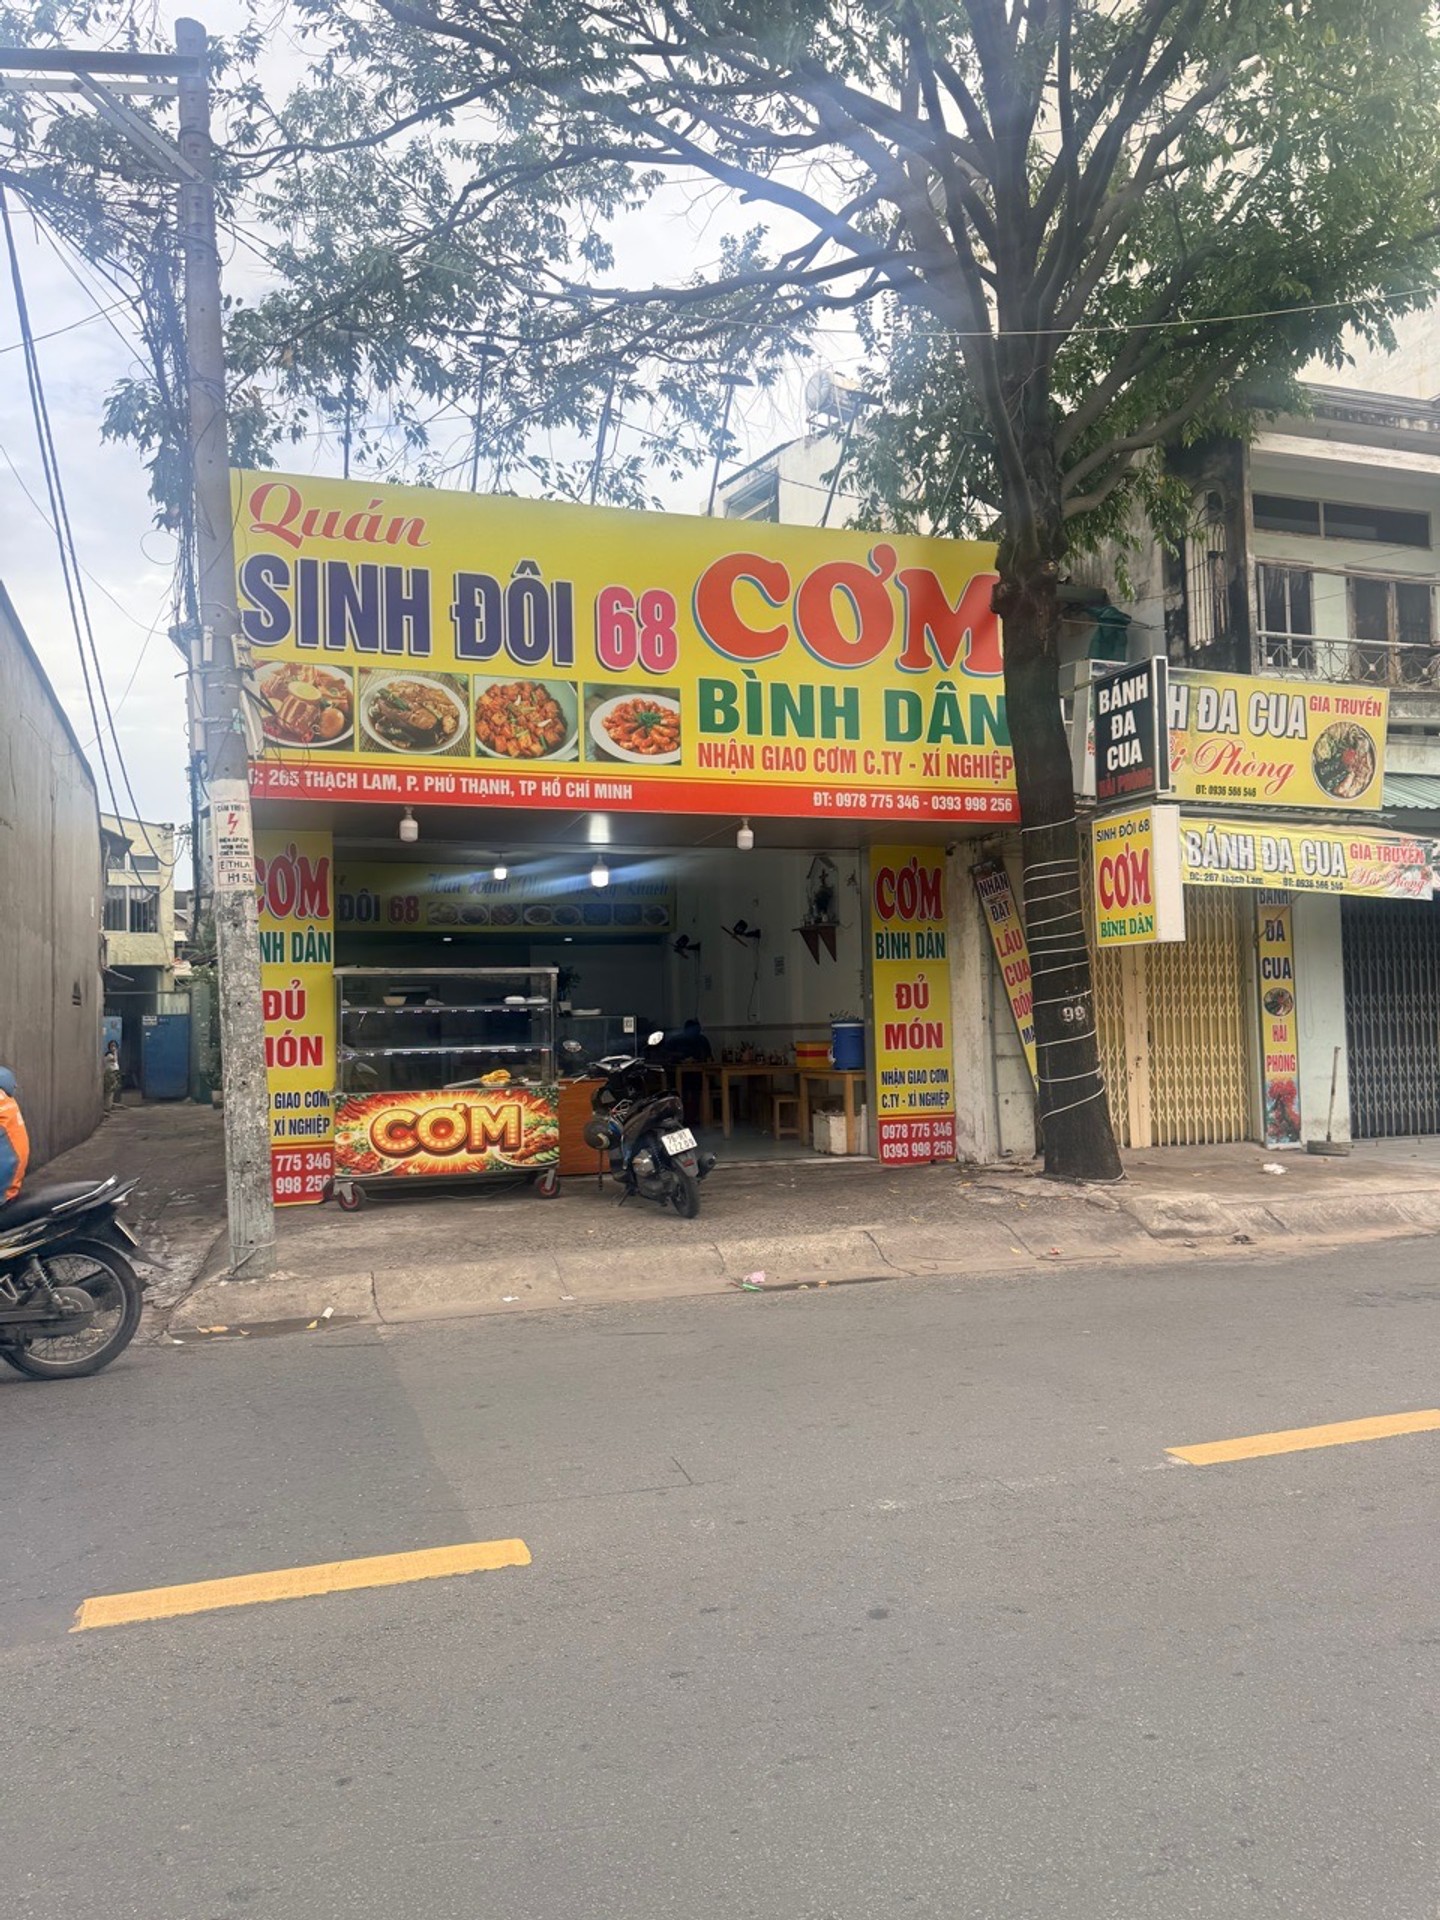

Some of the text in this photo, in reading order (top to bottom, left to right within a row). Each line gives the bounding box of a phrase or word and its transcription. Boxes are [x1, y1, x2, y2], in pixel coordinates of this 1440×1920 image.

[248, 483, 431, 549] Quán
[240, 552, 678, 675] SINH ĐÔI 68
[692, 543, 1003, 677] CƠM
[698, 669, 1012, 747] BÌNH DÂN
[1098, 672, 1148, 715] BÁNH
[1309, 695, 1330, 712] GIA
[1110, 709, 1136, 740] ĐA
[1197, 687, 1239, 735] ĐA
[1248, 691, 1307, 739] CUA
[698, 738, 755, 775] NHẬN
[761, 745, 806, 772] GIAO
[813, 745, 857, 775] CƠM
[863, 750, 903, 776] C.TY
[922, 748, 940, 777] XÍ
[947, 750, 1013, 784] NGHIỆP
[1106, 738, 1143, 771] CUA
[1193, 737, 1295, 796] Phòng
[248, 767, 632, 799] C: 265 THẠCH LAM, P. PHÚ THẠNH, TP HỒ CHÍ MINH
[813, 792, 832, 807] ĐT:
[835, 794, 867, 808] 0978
[870, 795, 893, 809] 775
[896, 796, 919, 810] 346
[931, 796, 961, 811] 0393
[965, 797, 987, 811] 998
[990, 797, 1012, 812] 256
[1097, 819, 1150, 842] SINH ĐÔI 68
[1185, 824, 1348, 878] BÁNH ĐA CUA
[1350, 843, 1372, 860] GIA
[874, 856, 943, 921] CƠM
[1099, 842, 1151, 910] CƠM
[338, 888, 420, 924] ĐÔI 68
[1100, 912, 1153, 937] BÌNH DÂN
[259, 925, 331, 963] NH DÂN
[875, 927, 946, 959] BÌNH DÂN
[1005, 959, 1031, 986] CUA
[1262, 957, 1292, 979] CUA
[262, 979, 306, 1021] ĐỦ
[895, 973, 929, 1010] ĐỦ
[884, 1018, 943, 1051] MÓN
[1272, 1018, 1287, 1042] HẢI
[1266, 1050, 1295, 1072] PHÒNG
[881, 1068, 949, 1088] NHẬN GIAO CƠM
[275, 1092, 300, 1109] GIAO
[305, 1090, 329, 1108] CƠM
[882, 1094, 899, 1108] C.TY
[908, 1090, 917, 1107] XÍ
[919, 1089, 950, 1109] NGHIỆP
[274, 1114, 330, 1138] XÍ NGHIỆP
[370, 1103, 521, 1157] CƠM
[882, 1122, 952, 1139] 0978 775 346
[275, 1152, 331, 1172] 775 346
[883, 1141, 953, 1158] 0393 998 256
[276, 1176, 301, 1194] 998
